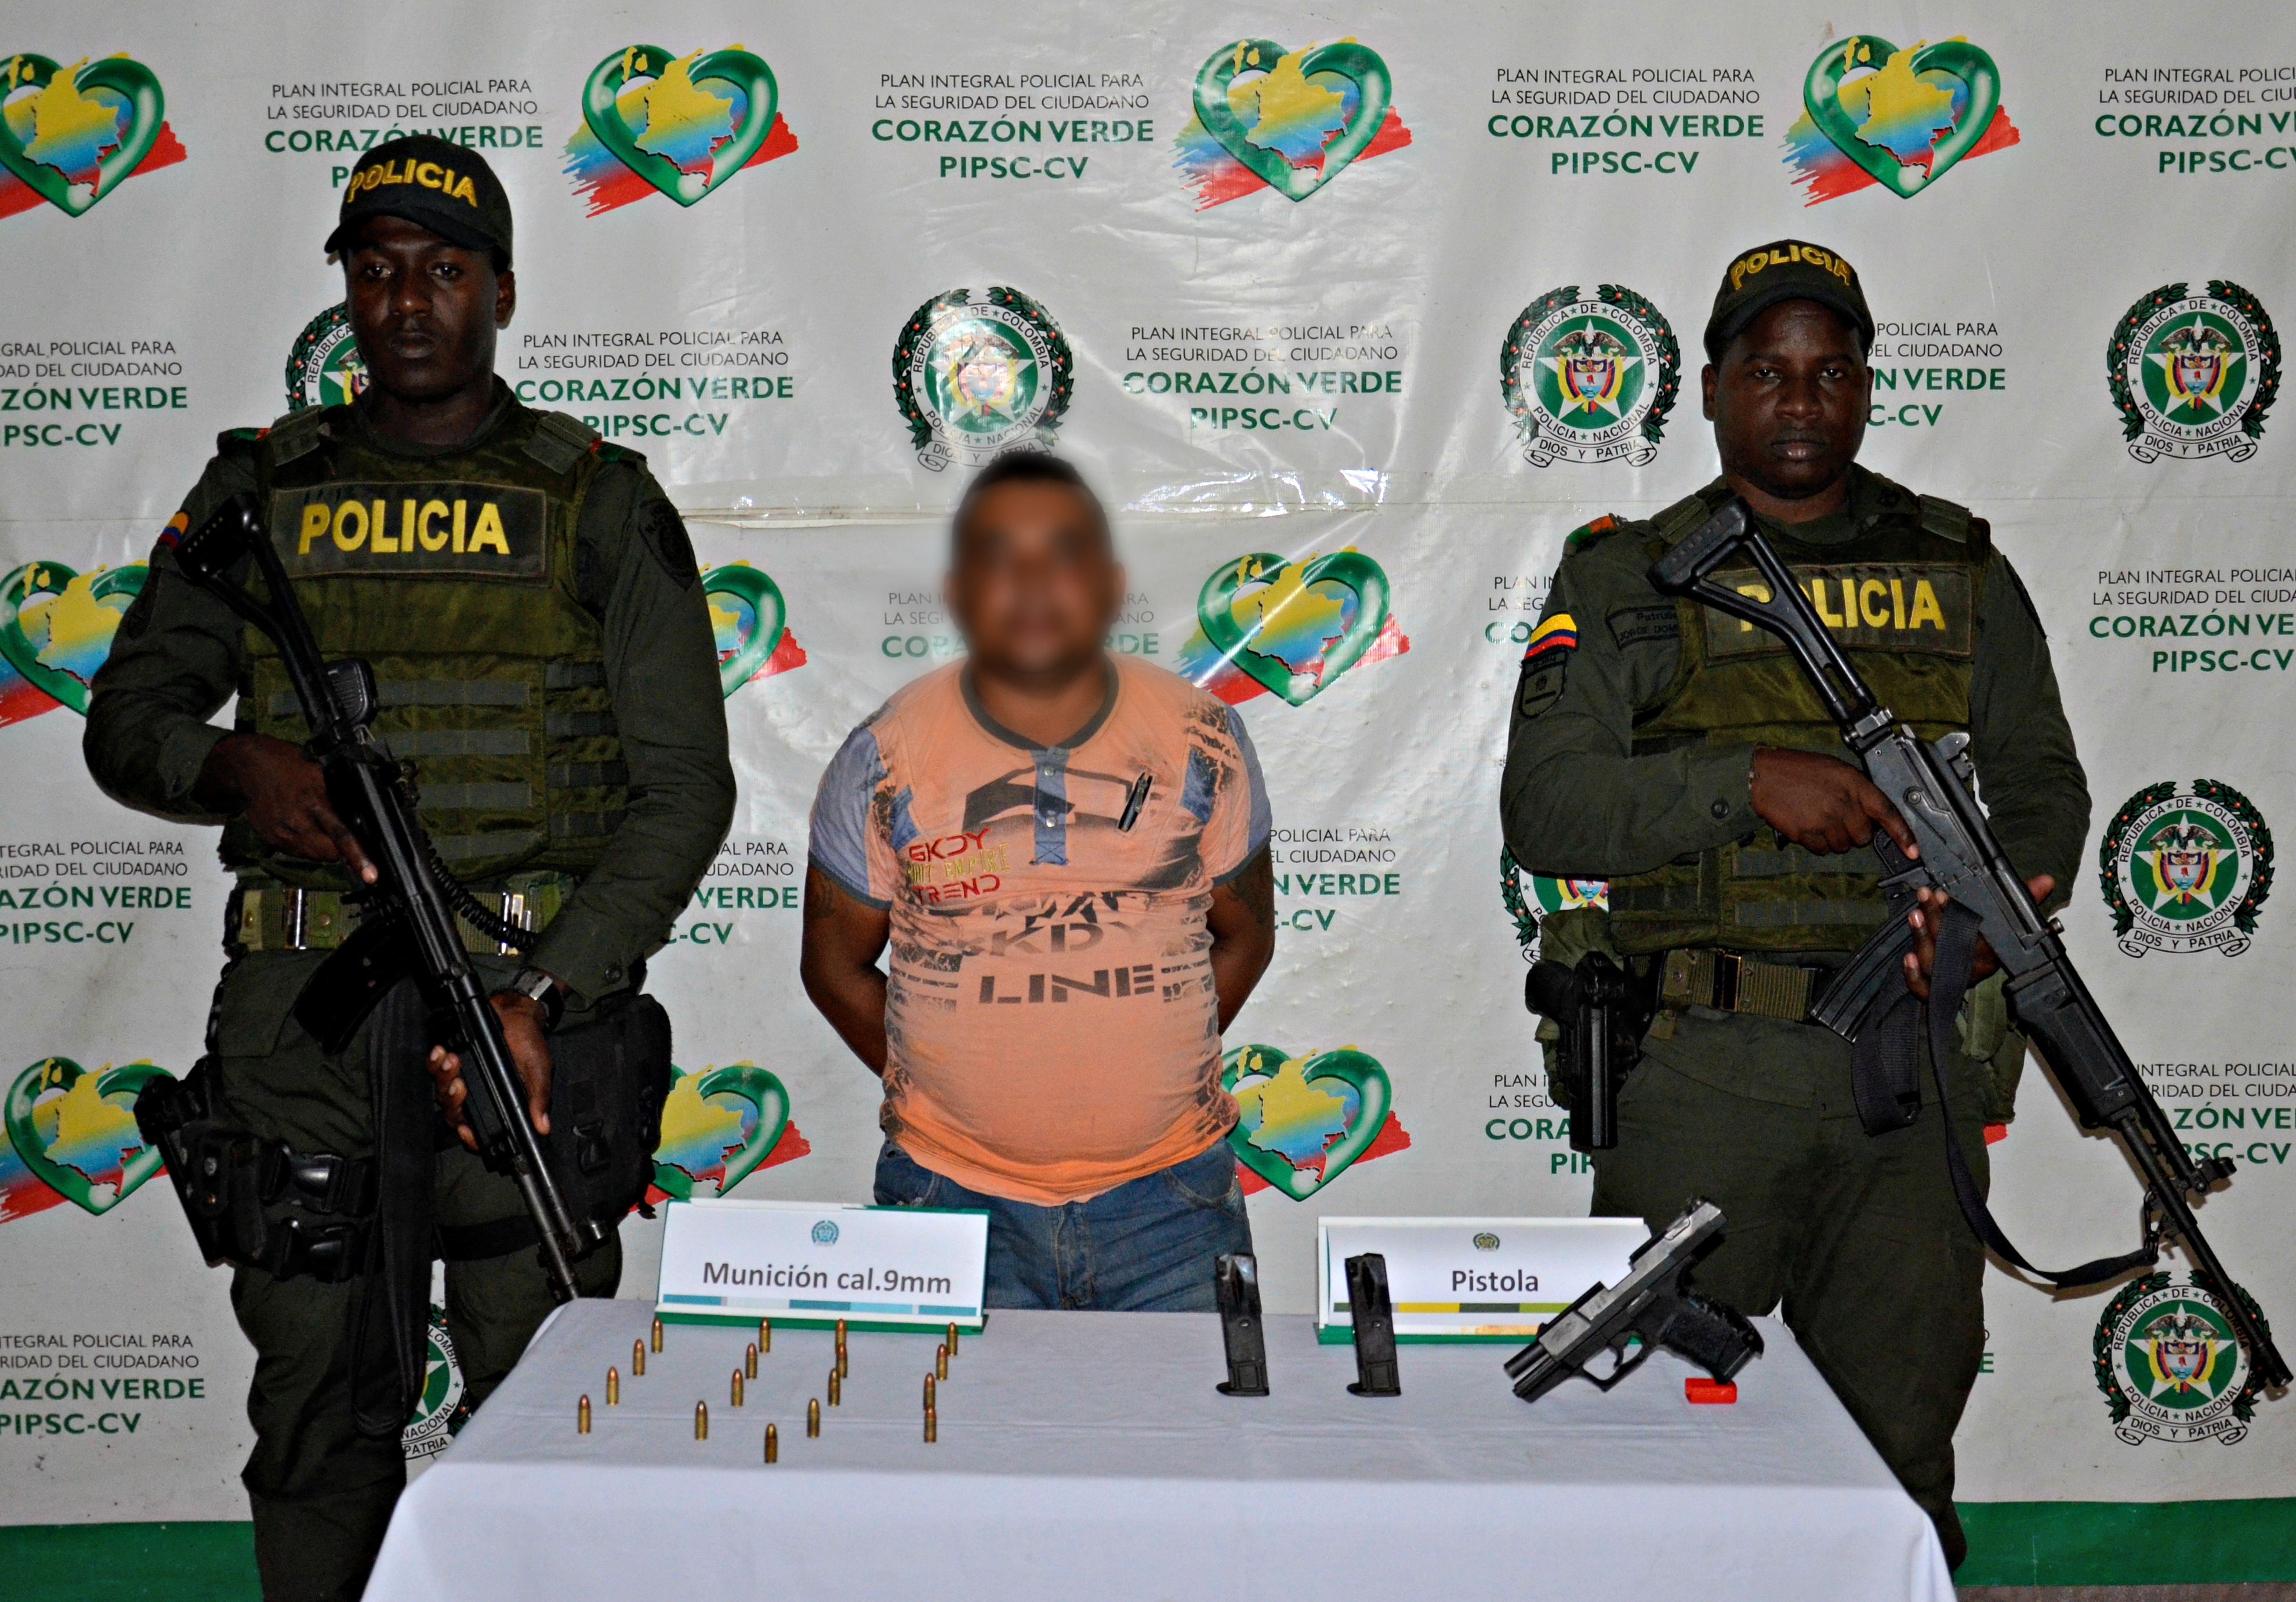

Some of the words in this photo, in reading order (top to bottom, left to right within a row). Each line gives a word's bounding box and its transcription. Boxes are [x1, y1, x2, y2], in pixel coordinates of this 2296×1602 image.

[882, 74, 924, 88] PLAN
[931, 75, 1015, 88] INTEGRAL
[1021, 74, 1096, 88] POLICIAL
[1102, 74, 1143, 87] PARA
[1497, 68, 1538, 82] PLAN
[1545, 70, 1627, 83] INTEGRAL
[1633, 69, 1707, 82] POLICIAL
[1713, 69, 1754, 82] PARA
[2106, 69, 2148, 82] PLAN
[2154, 69, 2233, 82] INTEGRAL
[273, 85, 315, 97] PLAN
[322, 83, 406, 96] INTEGRAL
[412, 81, 483, 96] POLICIAL
[489, 79, 531, 92] PARA
[1492, 90, 1511, 103] LA
[1517, 90, 1611, 104] SEGURIDAD
[1617, 90, 1647, 103] DEL
[1653, 90, 1760, 104] CIUDADANO
[2100, 90, 2119, 103] LA
[2125, 90, 2218, 103] SEGURIDAD
[2224, 90, 2255, 103] DEL
[268, 106, 287, 119] LA
[293, 104, 390, 119] SEGURIDAD
[397, 104, 427, 118] DEL
[433, 101, 537, 117] CIUDADANO
[876, 95, 895, 108] LA
[902, 96, 998, 109] SEGURIDAD
[1005, 96, 1036, 109] DEL
[1042, 95, 1149, 109] CIUDADANO
[872, 114, 1041, 142] CORAZÓN
[1047, 119, 1154, 143] VERDE
[1488, 109, 1652, 138] CORAZÓN
[1659, 115, 1764, 137] VERDE
[2095, 108, 2262, 137] CORAZÓN
[438, 126, 543, 148] VERDE
[940, 156, 1088, 179] PIPSC-CV
[1552, 151, 1699, 175] PIPSC-CV
[348, 158, 477, 208] POLICIA
[1731, 244, 1850, 290] POLICIA
[524, 335, 566, 347] PLAN
[574, 333, 654, 347] INTEGRAL
[660, 332, 735, 345] POLICIAL
[741, 331, 783, 344] PARA
[970, 307, 988, 317] DE
[1002, 311, 1049, 369] COLOMBIA
[1132, 327, 1174, 340] PLAN
[1181, 328, 1263, 340] INTEGRAL
[1350, 326, 1392, 339] PARA
[1522, 310, 1569, 369] REPUBLICA
[1580, 303, 1598, 314] DE
[1611, 308, 1657, 366] COLOMBIA
[1877, 323, 1951, 336] POLICIAL
[1957, 323, 1998, 336] PARA
[2129, 307, 2178, 365] REPUBLICA
[2189, 300, 2207, 310] DE
[2219, 305, 2258, 362] COLOMBIA
[50, 342, 125, 355] POLICIAL
[132, 342, 176, 354] PARA
[1127, 348, 1146, 361] LA
[1152, 348, 1247, 362] SEGURIDAD
[1254, 348, 1285, 361] DEL
[1291, 346, 1397, 361] CIUDADANO
[1898, 344, 2003, 357] CIUDADANO
[36, 364, 65, 377] DEL
[71, 362, 182, 376] CIUDADANO
[519, 356, 538, 369] LA
[545, 354, 639, 368] SEGURIDAD
[645, 354, 675, 366] DEL
[681, 352, 788, 366] CIUDADANO
[515, 372, 681, 401] CORAZÓN
[688, 376, 793, 399] VERDE
[1123, 367, 1290, 394] CORAZÓN
[1296, 371, 1401, 393] VERDE
[1903, 368, 2005, 390] VERDE
[78, 387, 187, 410] VERDE
[986, 405, 1043, 445] NACIONAL
[1191, 408, 1337, 430] PIPSC-CV
[1533, 406, 1577, 441] POLICIA
[1593, 402, 1649, 442] NACIONAL
[2139, 402, 2182, 437] POLICIA
[2196, 399, 2251, 437] NACIONAL
[1539, 439, 1568, 456] DIOS
[1578, 449, 1586, 459] Y
[1597, 439, 1642, 459] PATRIA
[2145, 435, 2173, 452] DIOS
[2182, 445, 2189, 455] Y
[2198, 435, 2242, 453] PATRIA
[298, 499, 510, 555] POLICIA
[2099, 571, 2139, 584] PLAN
[2147, 570, 2225, 583] INTEGRAL
[889, 593, 931, 604] PLAN
[1489, 598, 1508, 611] LA
[1737, 579, 1946, 632] PLICIA
[2094, 592, 2112, 605] LA
[2118, 591, 2208, 605] SEGURIDAD
[2215, 590, 2245, 603] DEL
[884, 612, 905, 624] LA
[2089, 608, 2250, 638] CORAZÓN
[2153, 649, 2294, 673] PIPSC-CV
[1270, 829, 1344, 842] POLICIAL
[1350, 829, 1390, 841] PARA
[2119, 806, 2166, 863] REPUBLICA
[2177, 798, 2193, 808] DE
[2205, 802, 2250, 858] COLOMBIA
[71, 841, 144, 855] POLICIAL
[150, 842, 184, 855] PARA
[747, 842, 788, 855] PARA
[1290, 849, 1395, 863] CIUDADANO
[56, 863, 87, 876] DEL
[93, 862, 187, 876] CIUDADANO
[913, 874, 1000, 904] TREND
[1296, 873, 1400, 895] VERDE
[100, 886, 191, 909] VERDE
[694, 887, 797, 909] VERDE
[2129, 898, 2171, 931] POLICIA
[2186, 894, 2243, 932] NACIONAL
[2134, 930, 2162, 946] DIOS
[2172, 940, 2179, 949] Y
[2189, 929, 2235, 948] PATRIA
[979, 964, 1155, 1004] LINE
[1495, 1074, 1537, 1087] PLAN
[2138, 1064, 2219, 1077] INTEGRAL
[2210, 1084, 2239, 1097] DEL
[1489, 1095, 1509, 1108] LA
[703, 1262, 828, 1289] Munición
[837, 1268, 951, 1294] cal.9mm
[1452, 1269, 1539, 1292] Pistola
[2113, 1295, 2161, 1350] REPUBLICA
[2171, 1288, 2189, 1298] DE
[74, 1335, 147, 1347] POLICIAL
[153, 1335, 193, 1347] PARA
[59, 1355, 88, 1368] DEL
[94, 1355, 199, 1368] CIUDADANO
[100, 1378, 205, 1400] VERDE
[2124, 1386, 2169, 1419] POLICIA
[2185, 1385, 2241, 1421] NACIONAL
[0, 1412, 141, 1435] PIPSC-CV
[2131, 1418, 2160, 1435] DIOS
[2170, 1429, 2179, 1438] Y
[2189, 1419, 2233, 1437] PATRIA
[404, 1437, 448, 1455] PATRIA
